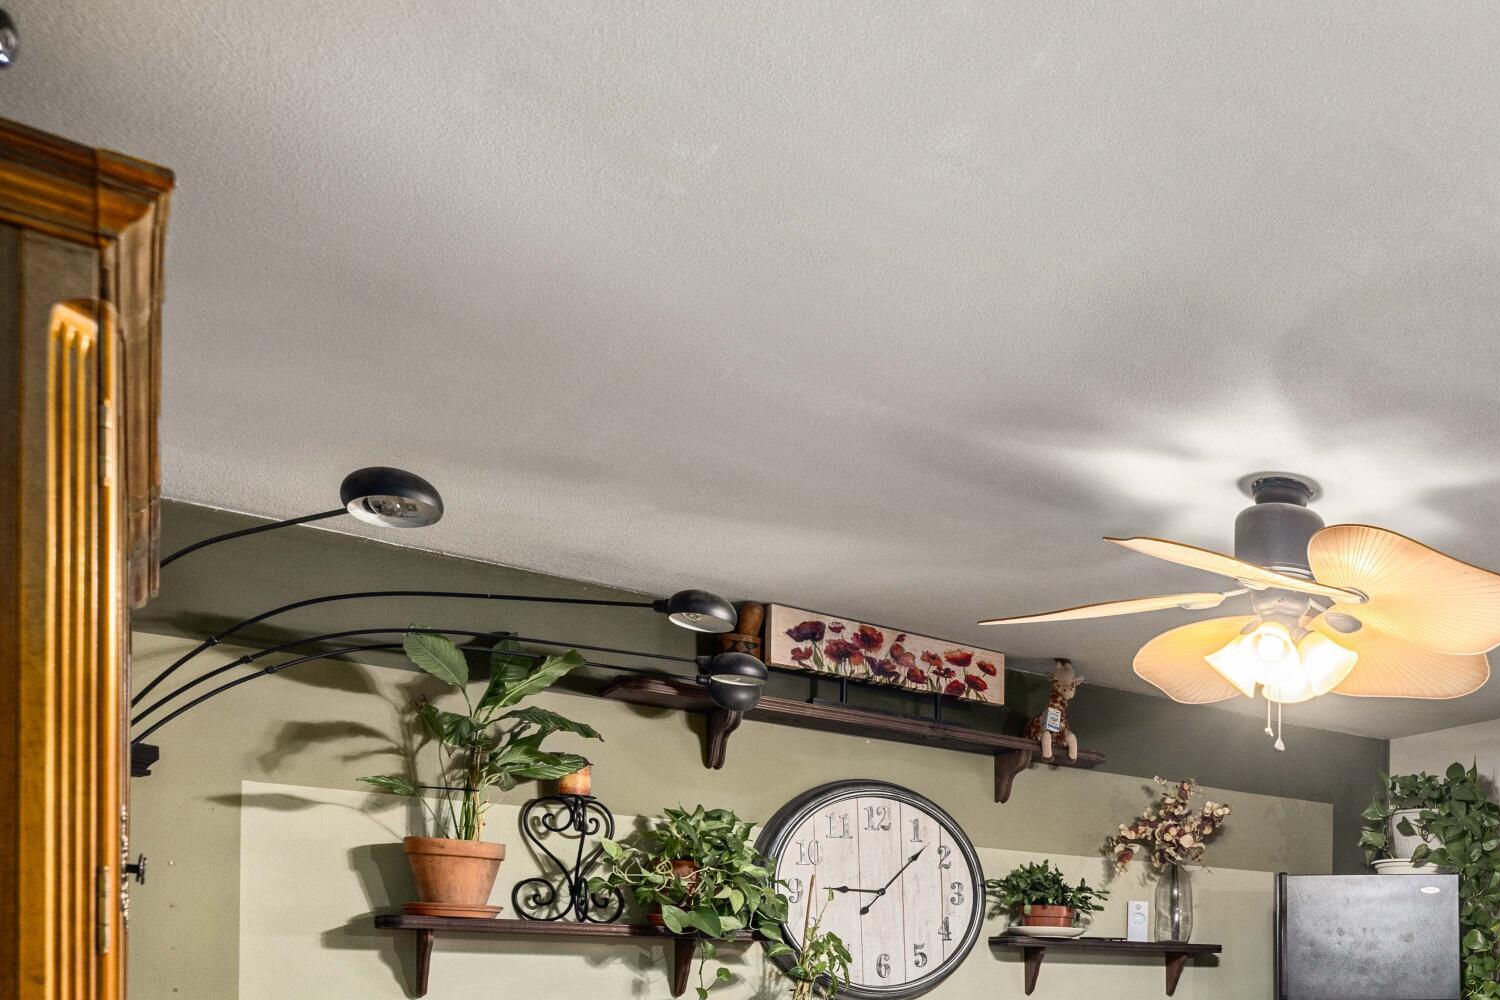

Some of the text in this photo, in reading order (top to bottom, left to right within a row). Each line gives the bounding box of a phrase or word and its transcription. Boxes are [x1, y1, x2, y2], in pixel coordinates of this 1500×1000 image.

[825, 813, 853, 839] 11
[864, 805, 892, 831] 12
[909, 818, 923, 843] 1
[796, 839, 823, 865] 10
[937, 845, 952, 869] 2
[788, 876, 803, 904] 9
[950, 881, 965, 906] 3
[937, 916, 952, 941] 4
[875, 953, 891, 978] 6
[913, 943, 928, 967] 5
